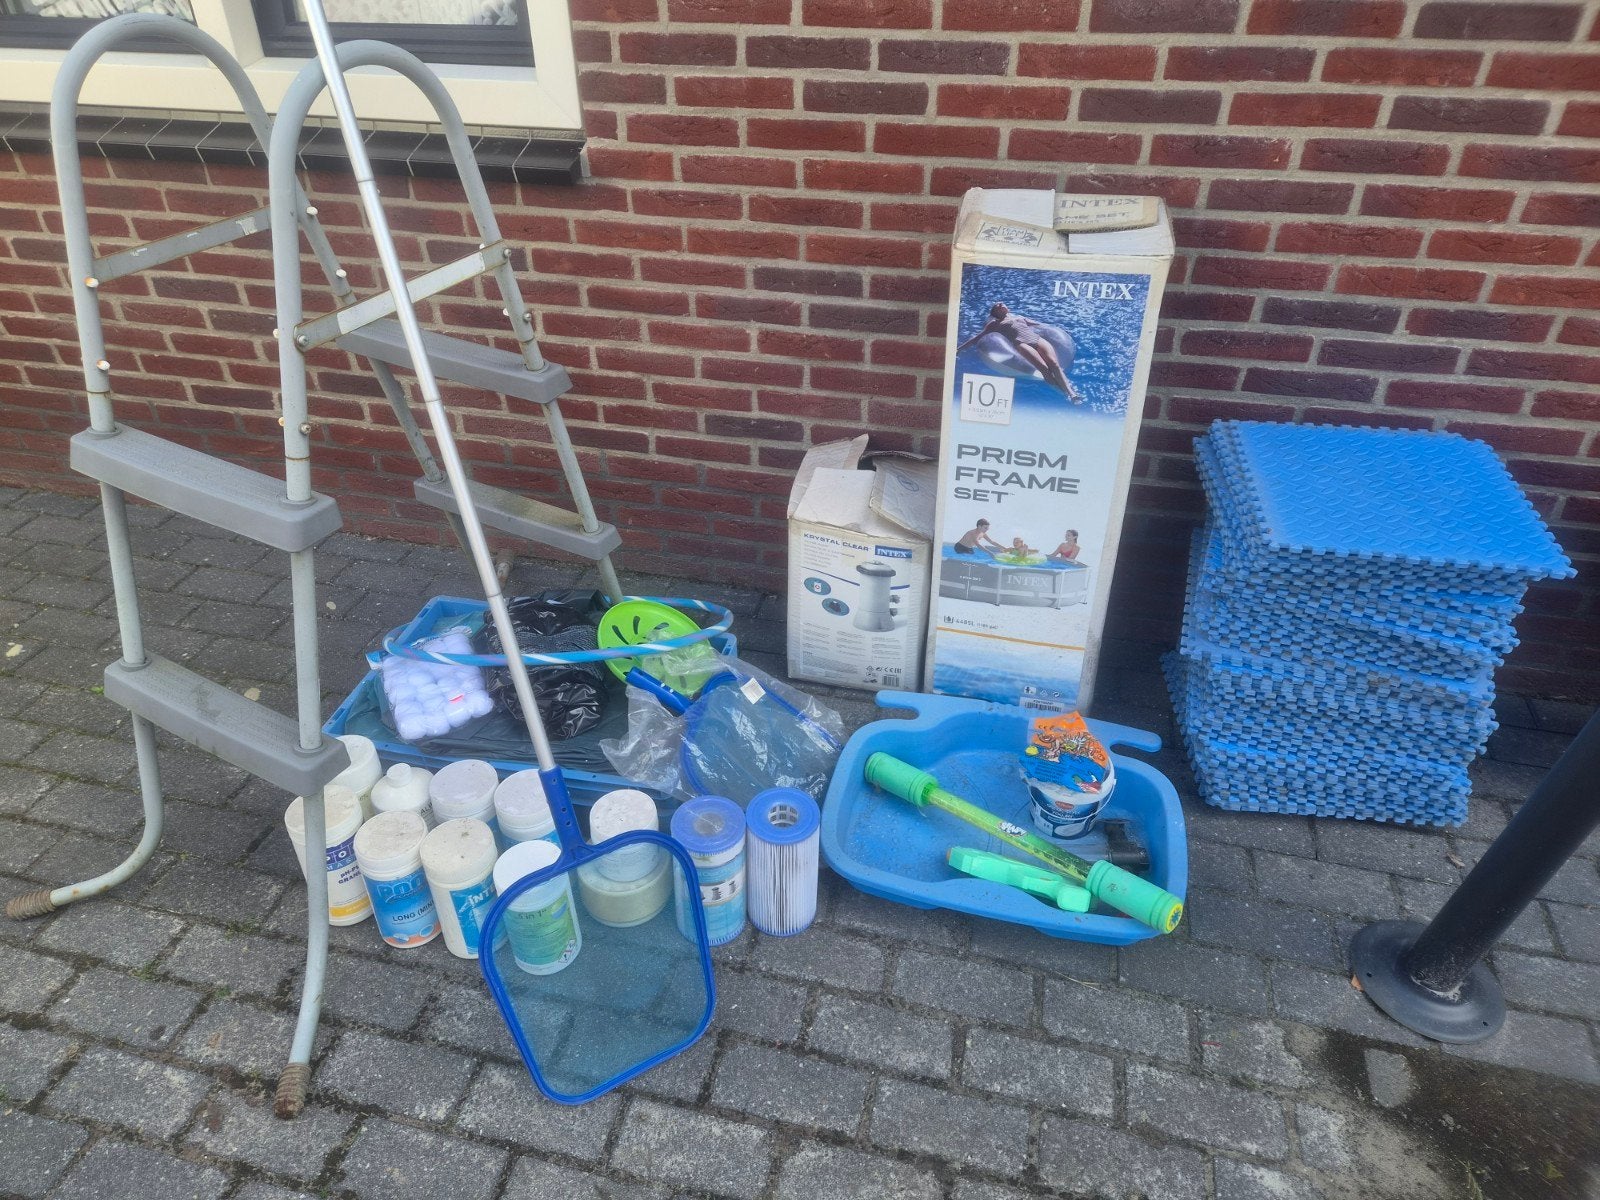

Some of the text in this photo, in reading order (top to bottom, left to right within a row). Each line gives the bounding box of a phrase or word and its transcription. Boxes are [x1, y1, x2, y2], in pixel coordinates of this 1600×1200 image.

[1060, 198, 1140, 208] INTEX
[1053, 280, 1136, 301] INTEX
[966, 380, 1009, 409] 10 FT
[957, 443, 1068, 471] PRISM
[955, 465, 1081, 495] FRAME
[803, 532, 869, 552] KRYSTAL CLEAR
[876, 547, 903, 558] INTEX
[1007, 574, 1049, 588] INTEX
[391, 911, 416, 922] LONG
